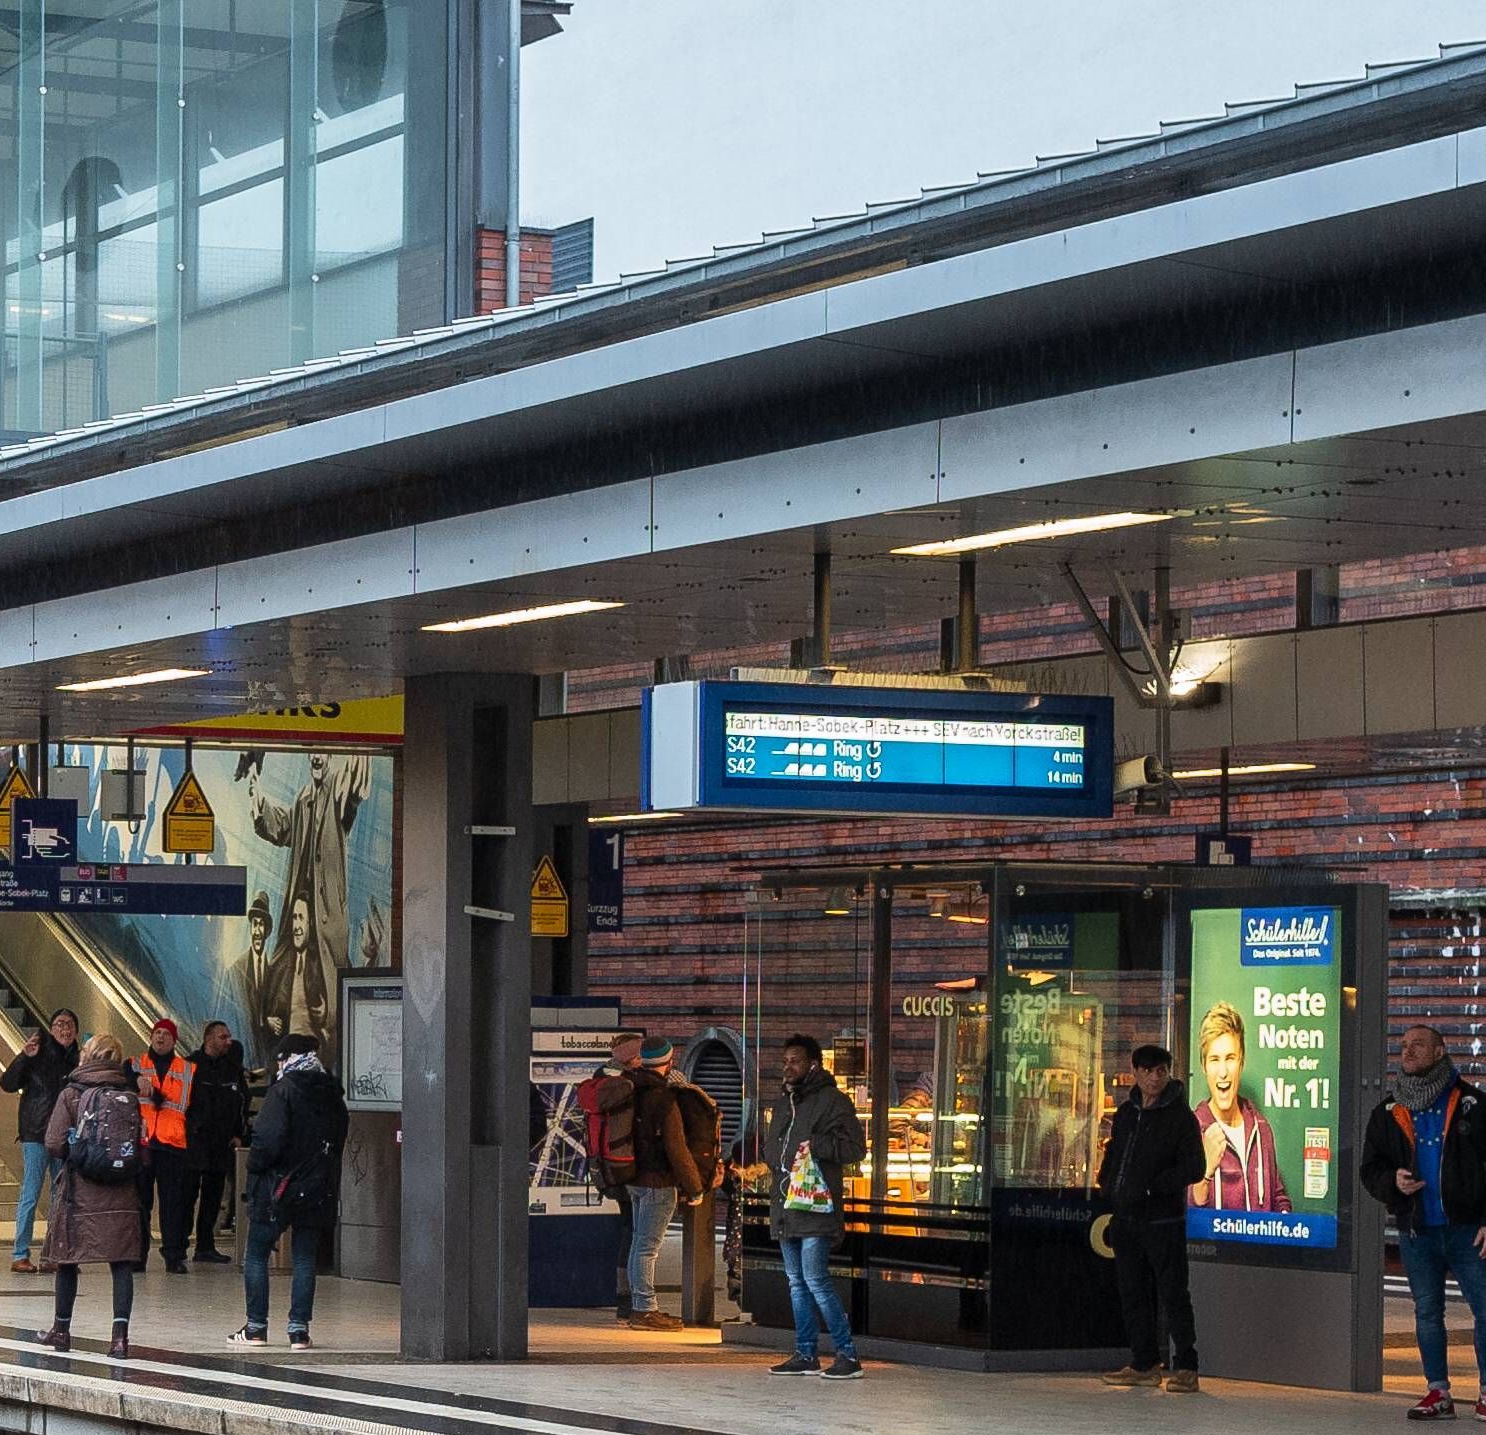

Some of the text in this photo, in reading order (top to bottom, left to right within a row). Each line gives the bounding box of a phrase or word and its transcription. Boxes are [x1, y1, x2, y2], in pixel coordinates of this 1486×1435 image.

[727, 737, 1083, 764] S42 Ring 4 min
[727, 758, 1083, 784] S42 Ring 14 min
[606, 833, 620, 870] 1
[596, 916, 618, 926] Ende
[1253, 986, 1326, 1017] Beste
[1258, 1024, 1324, 1049] Noten
[1277, 1055, 1320, 1071] mit der
[1264, 1077, 1300, 1108] Nr.
[1213, 1217, 1310, 1239] Schülerhilfe.de
